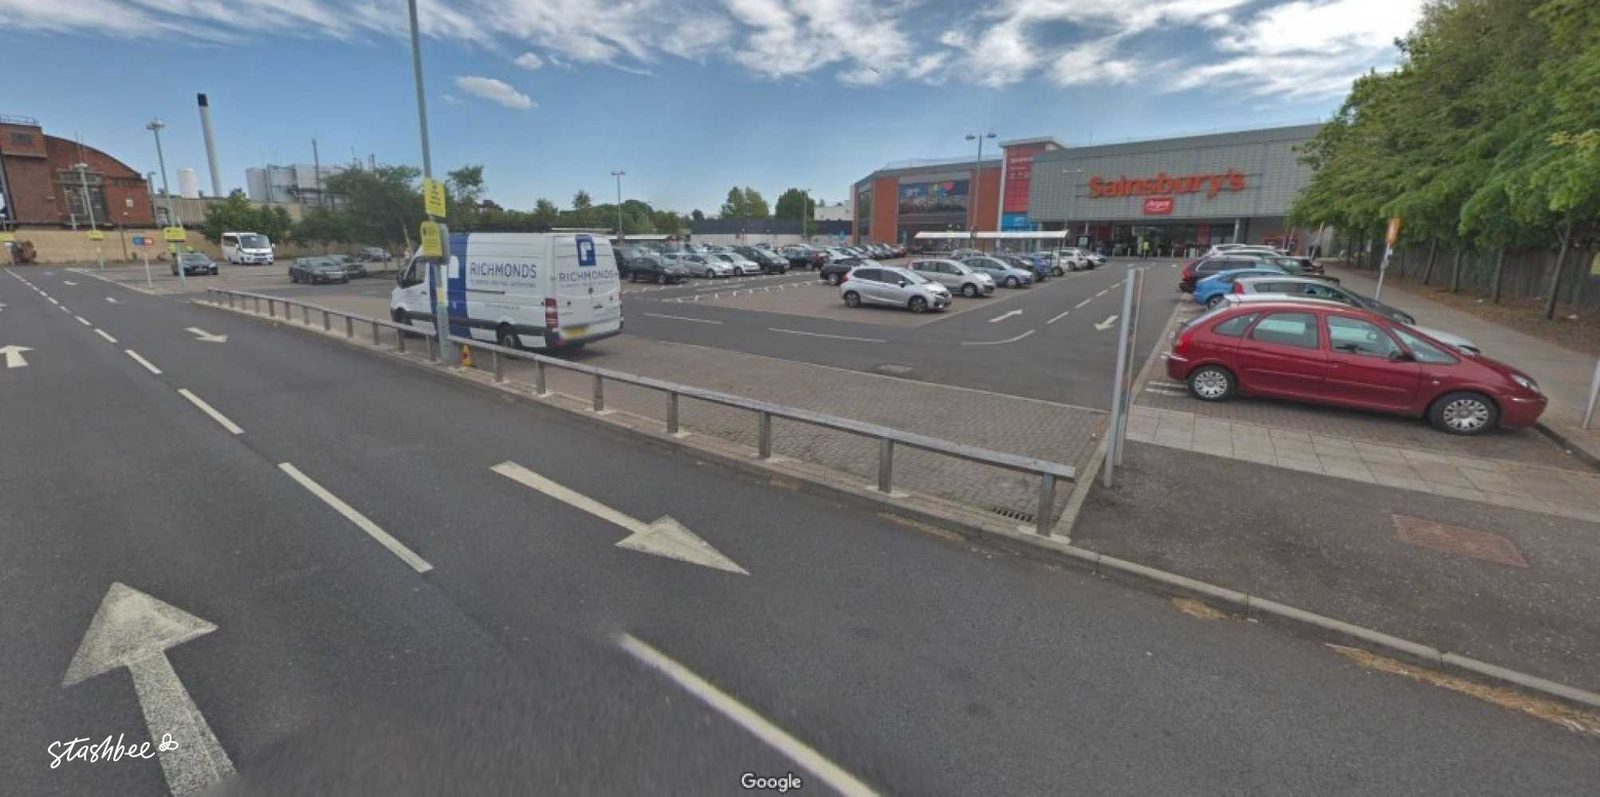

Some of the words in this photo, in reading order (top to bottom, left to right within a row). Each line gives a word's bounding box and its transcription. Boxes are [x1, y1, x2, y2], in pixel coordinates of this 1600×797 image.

[1088, 167, 1246, 199] Sainsbury's
[470, 262, 537, 279] RICHMONDS
[559, 269, 615, 282] RICHMONDS
